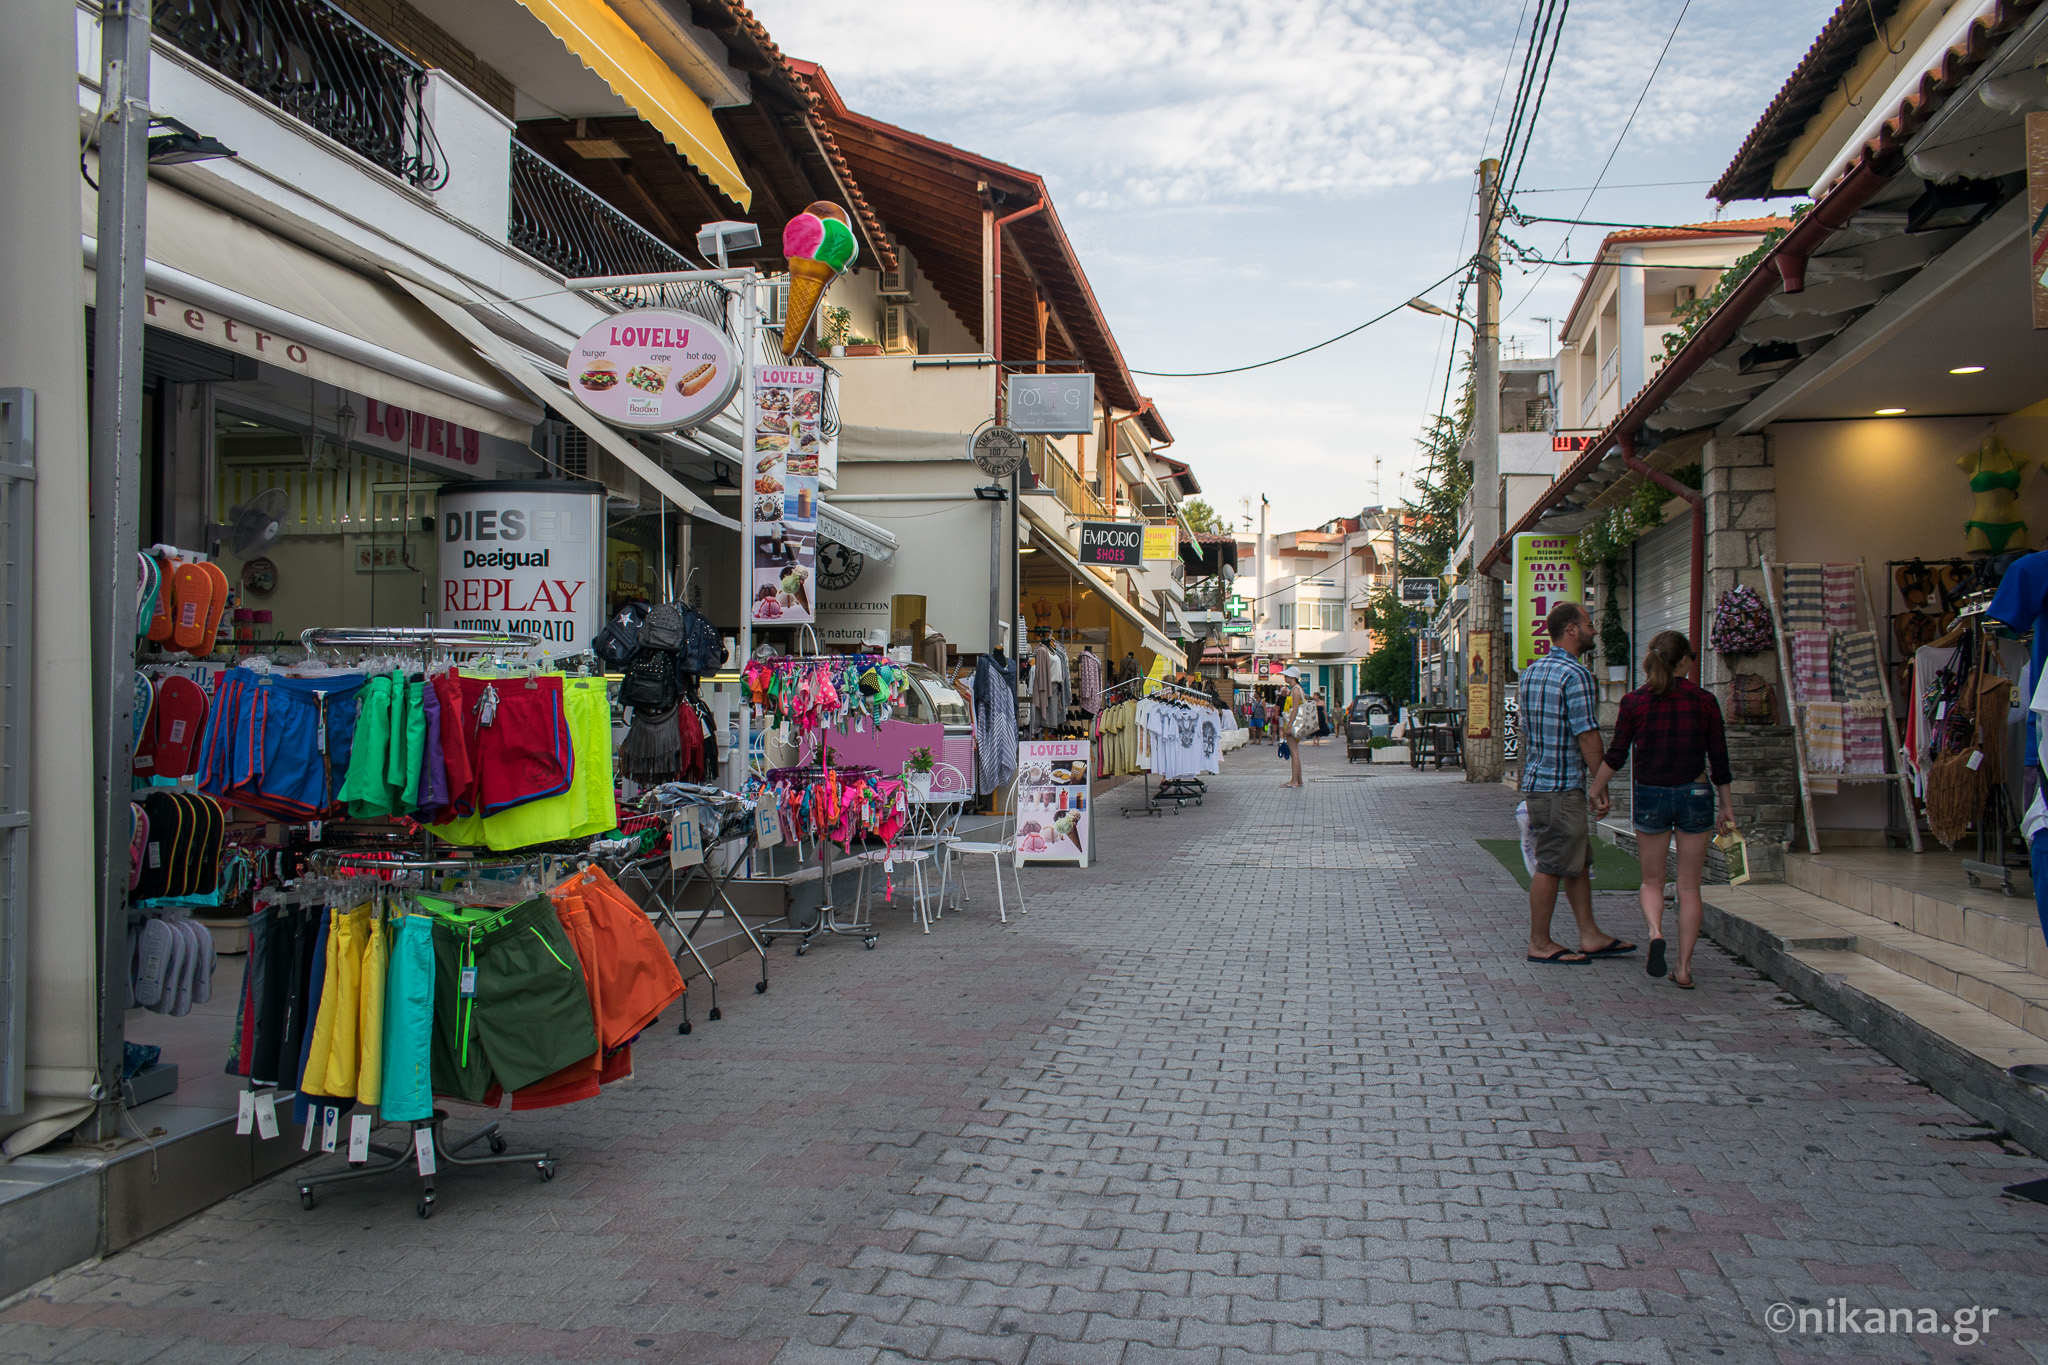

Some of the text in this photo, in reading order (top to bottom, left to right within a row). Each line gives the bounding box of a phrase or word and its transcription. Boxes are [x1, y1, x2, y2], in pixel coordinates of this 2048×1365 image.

[145, 294, 308, 364] retro
[610, 326, 690, 349] LOVELY
[582, 349, 607, 359] burger
[650, 353, 671, 363] crepe
[686, 352, 716, 362] hot dog
[763, 370, 815, 384] LOVELY
[366, 396, 480, 466] LOVELY
[446, 509, 587, 544] DIESEL
[1083, 529, 1140, 548] EMPORIO
[463, 547, 550, 571] Desigual
[1096, 547, 1126, 562] SHOES
[1534, 572, 1567, 581] ALL
[443, 577, 587, 614] REPLAY
[829, 601, 890, 611] COLLECTION
[828, 627, 867, 639] natural
[1030, 744, 1079, 757] LOVELY
